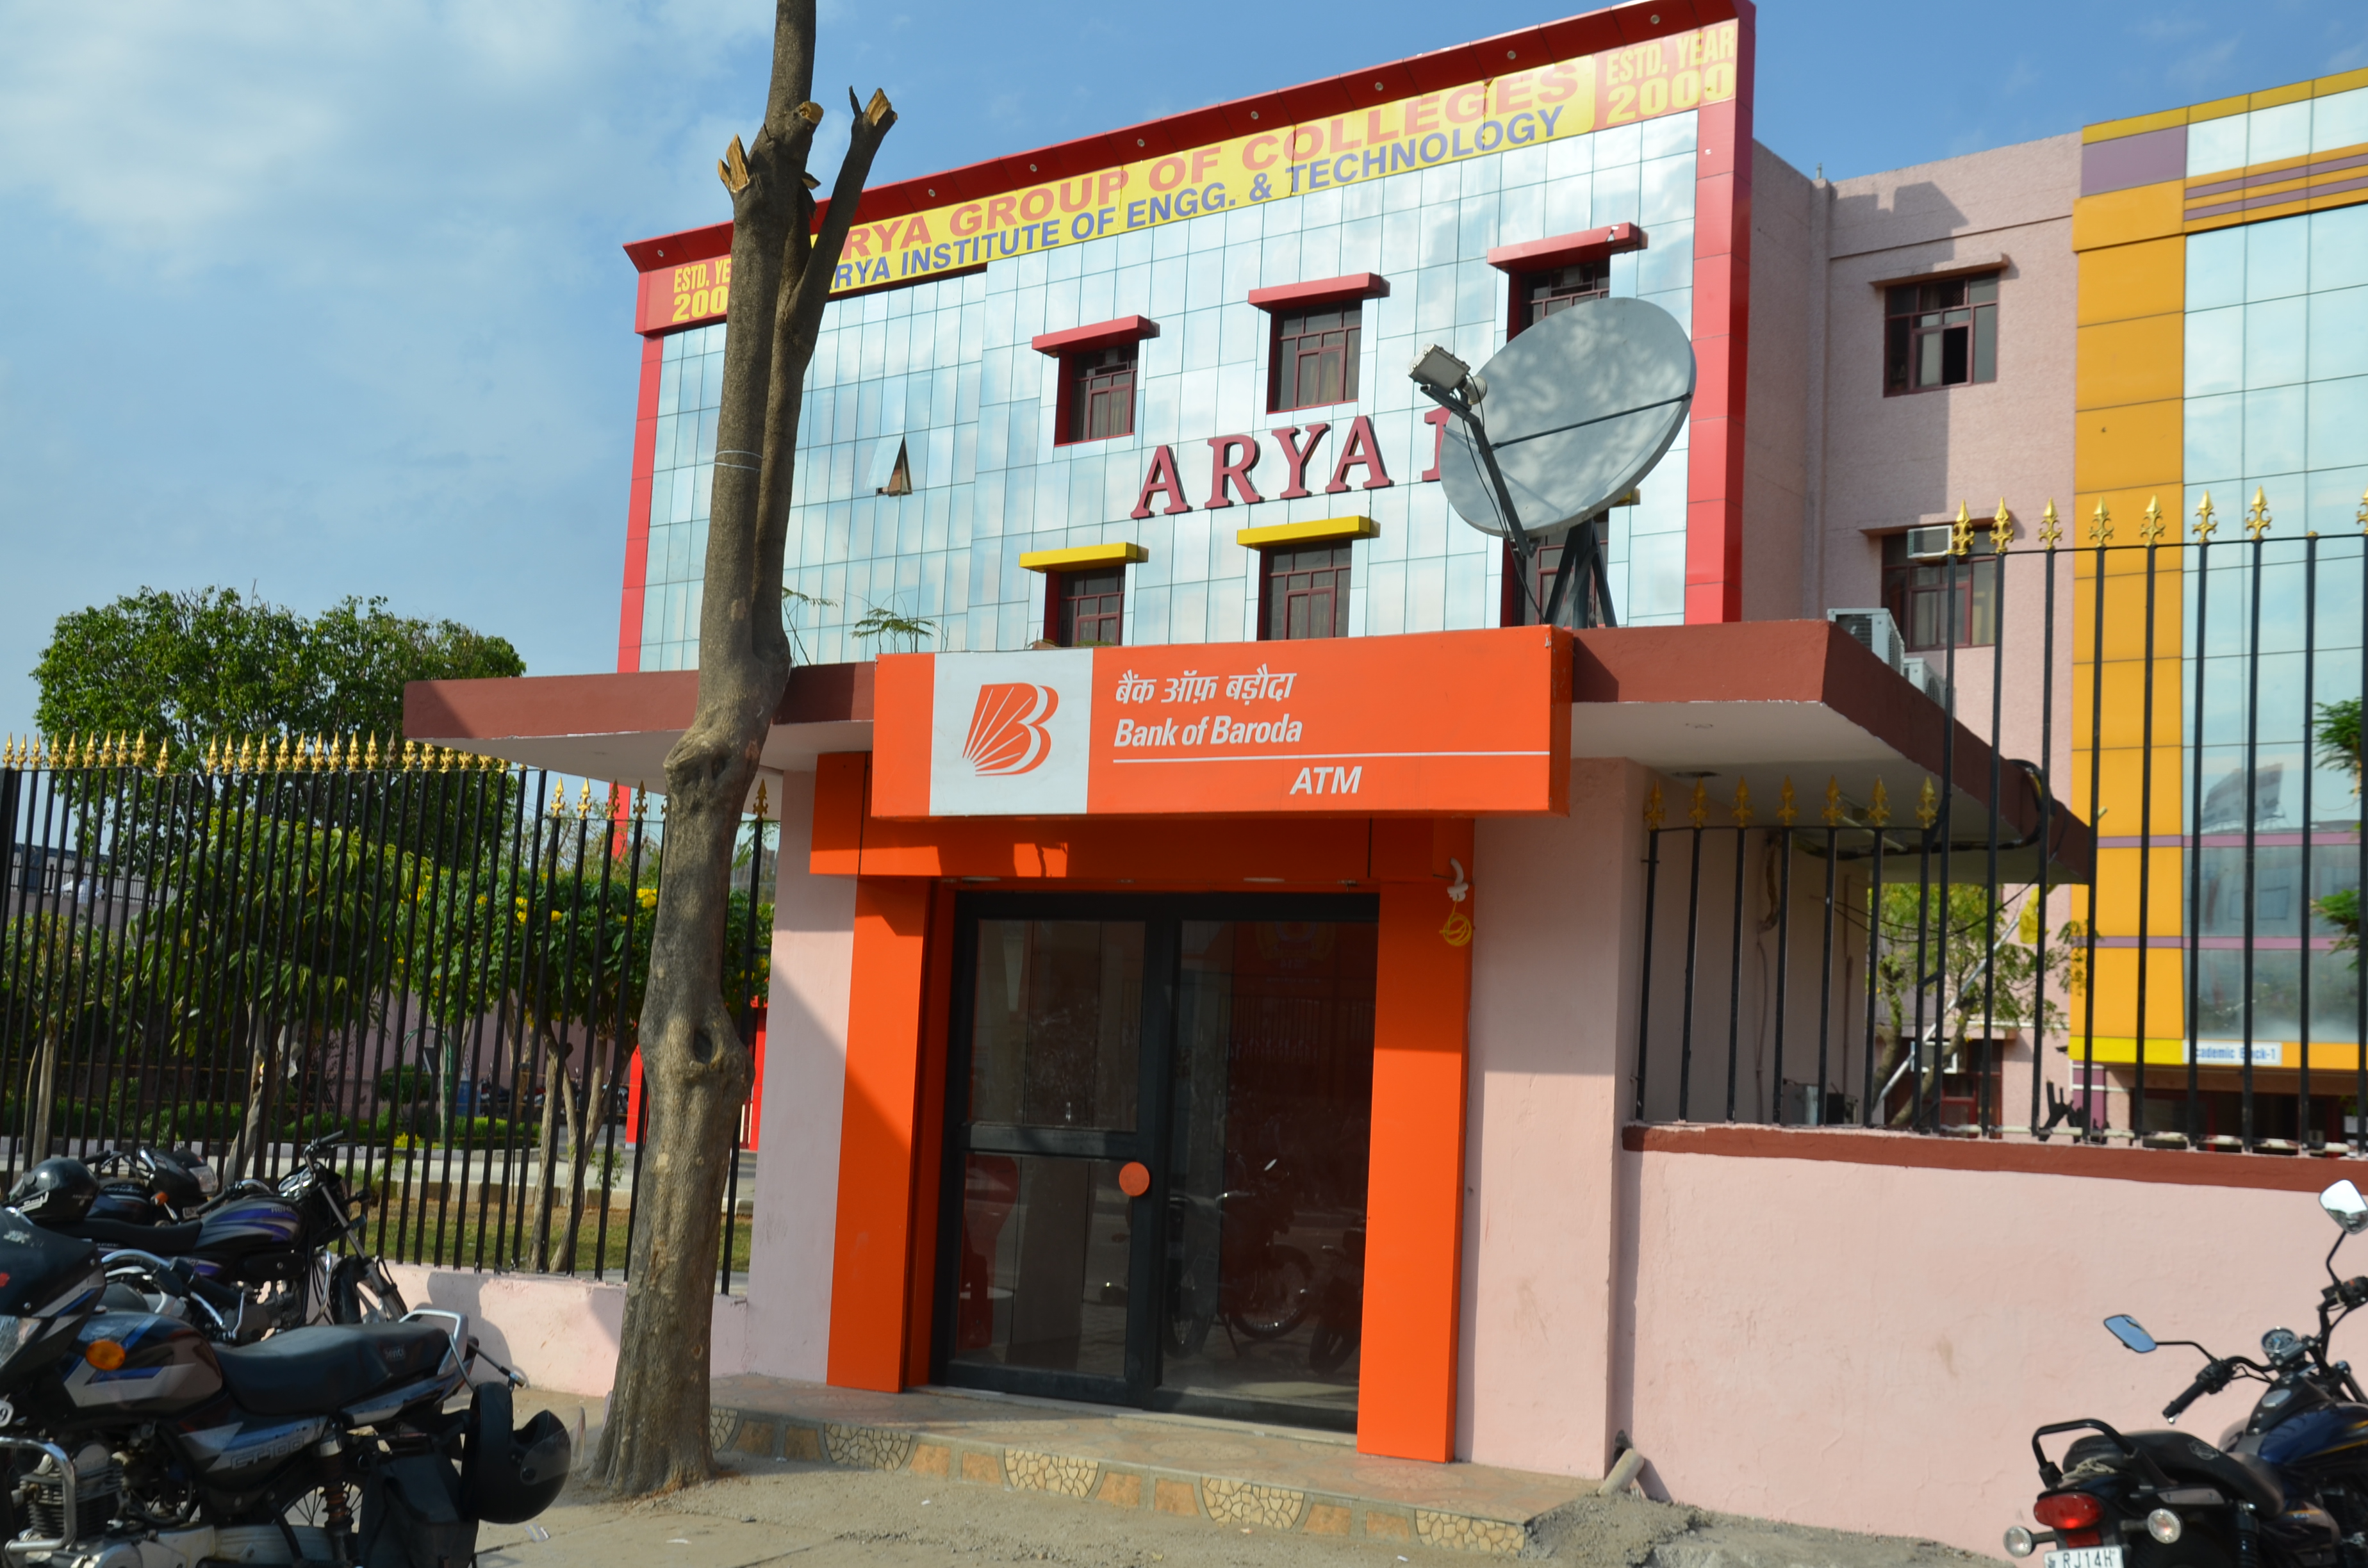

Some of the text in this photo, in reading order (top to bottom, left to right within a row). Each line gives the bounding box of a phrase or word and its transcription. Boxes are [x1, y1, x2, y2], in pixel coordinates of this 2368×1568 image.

[1605, 24, 1735, 87] ESTD. YEAR
[1607, 62, 1734, 125] 2000
[842, 63, 1579, 261] RYA GROUP OF COLLEGES
[830, 106, 1564, 290] RYA INSTITUTE OF ENGG. & TECHNOLOGY
[673, 257, 732, 293] ESTD. YE
[672, 285, 728, 322] 200
[1130, 415, 1395, 519] ARYA
[1115, 669, 1157, 704] बैंक
[1226, 663, 1297, 706] बड़ौदा
[1114, 713, 1303, 747] Bank of Baroda
[1290, 766, 1362, 796] ATM
[2196, 1046, 2235, 1059] cademic
